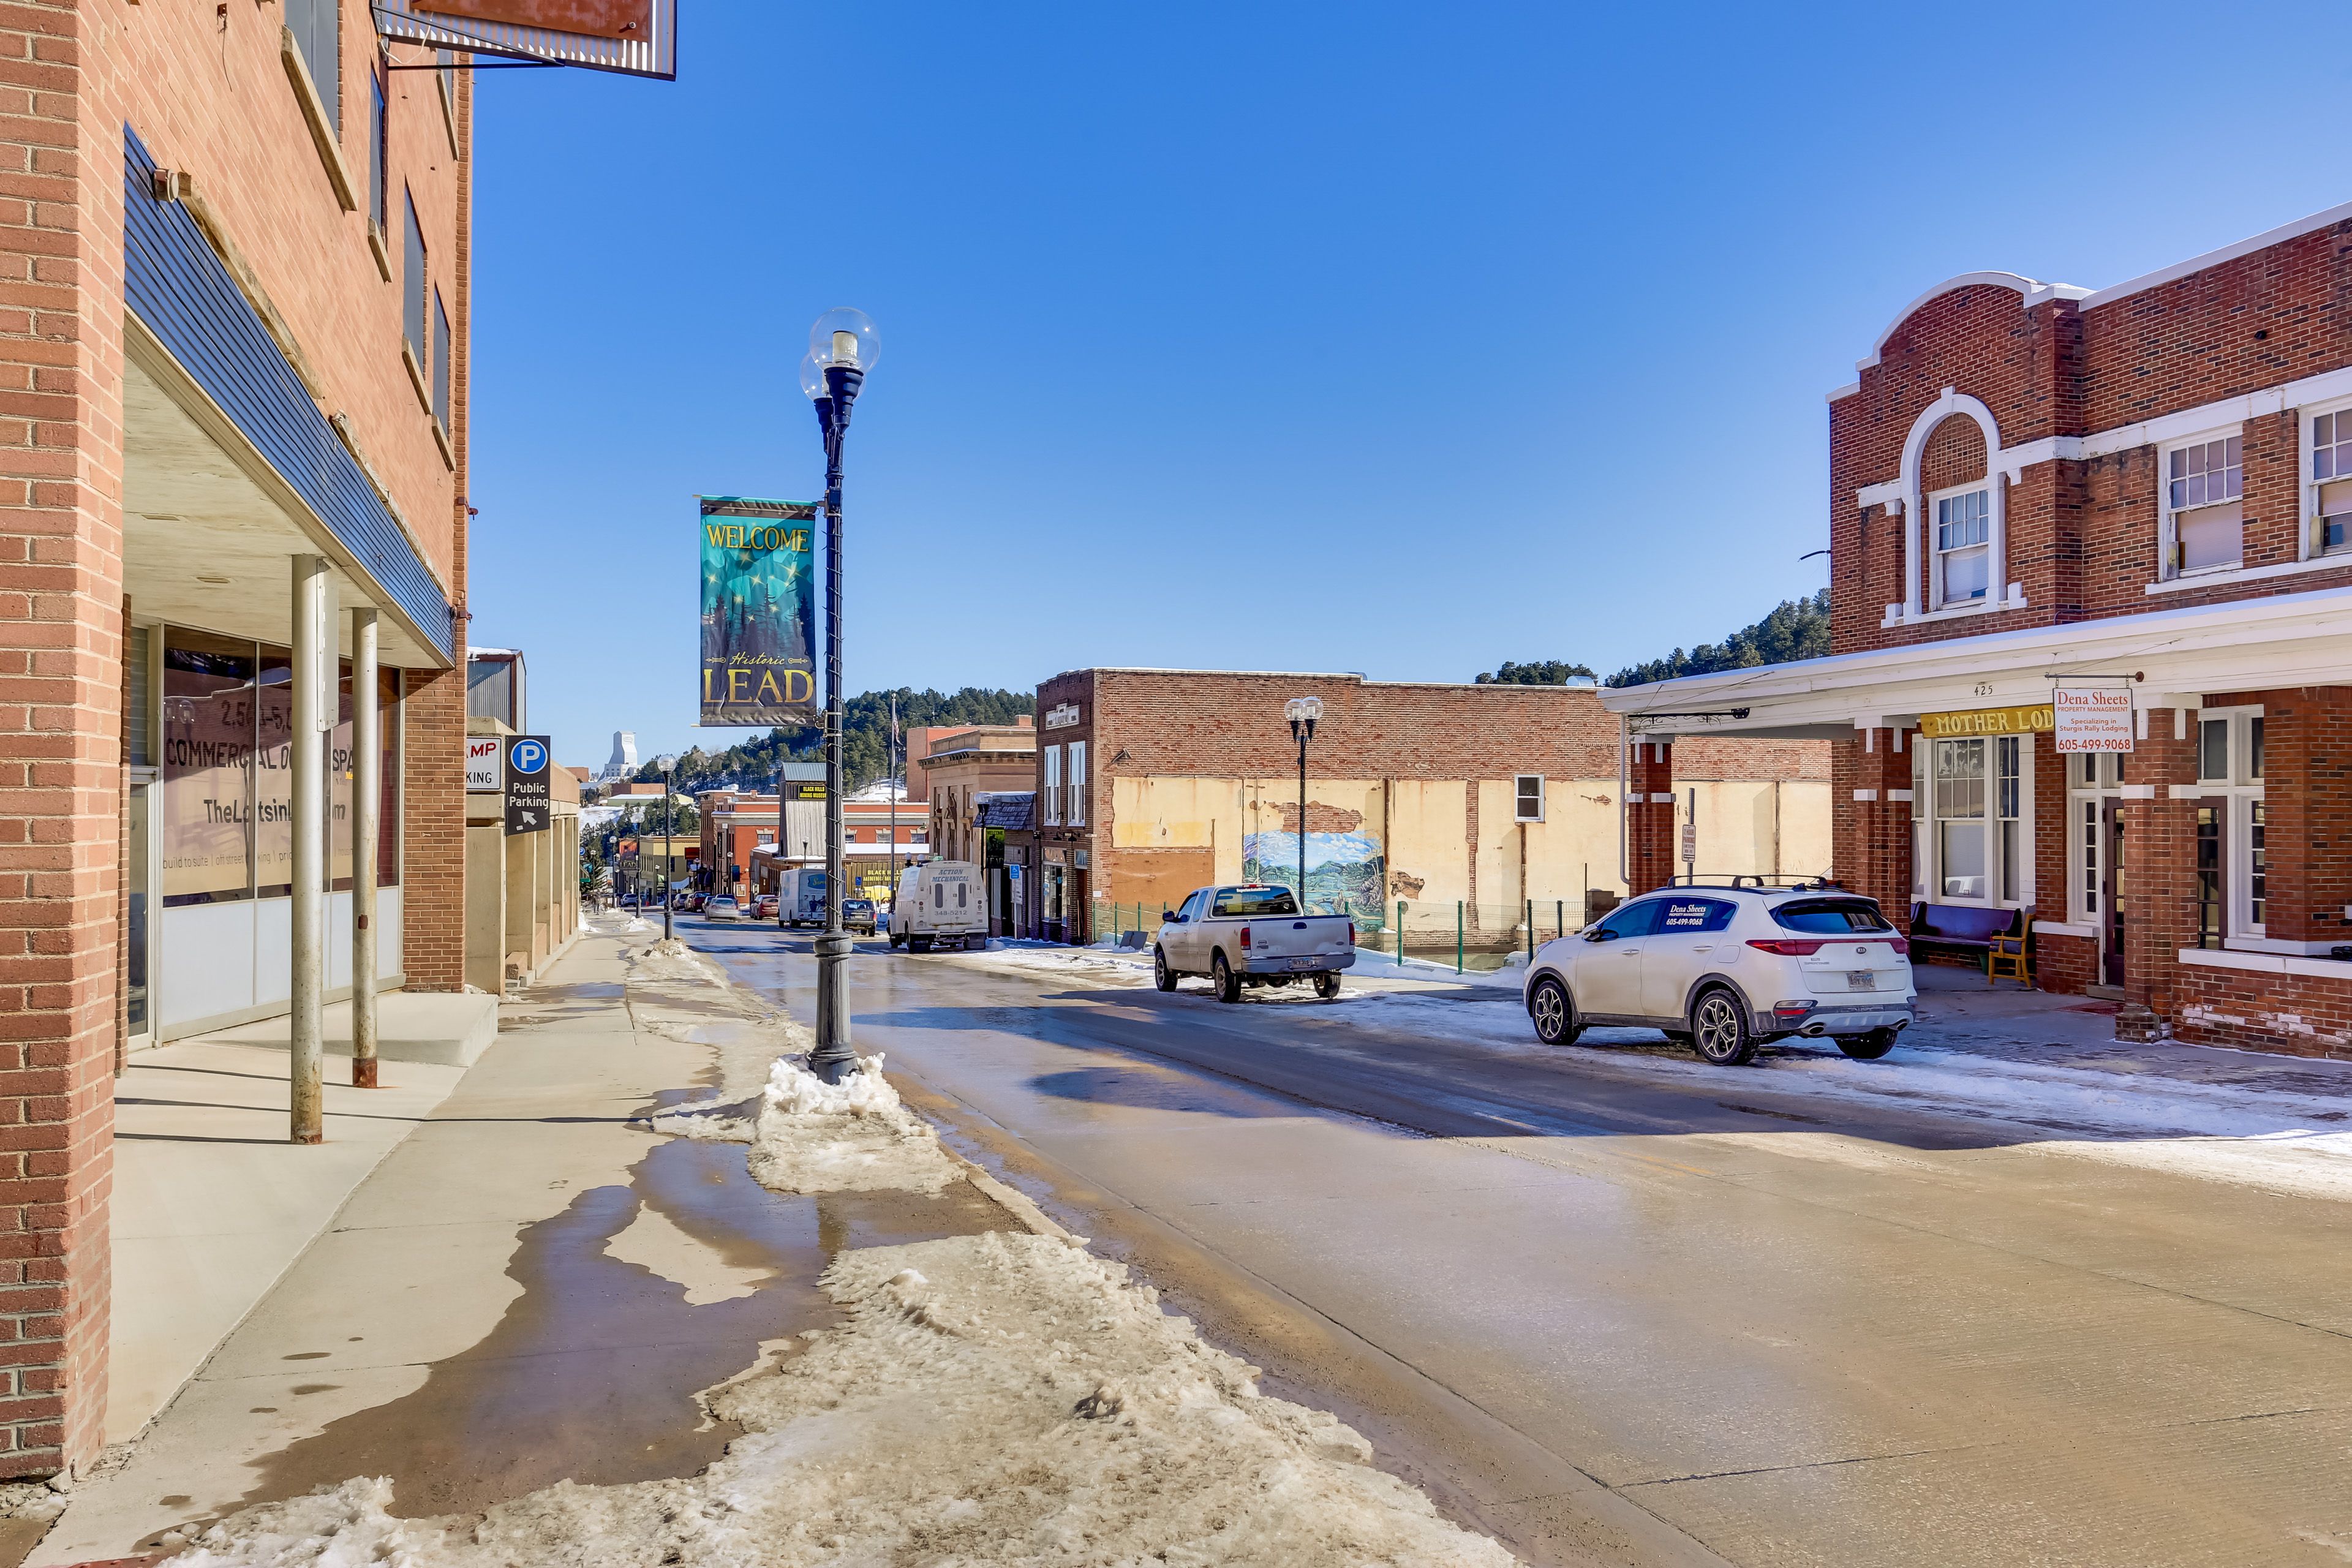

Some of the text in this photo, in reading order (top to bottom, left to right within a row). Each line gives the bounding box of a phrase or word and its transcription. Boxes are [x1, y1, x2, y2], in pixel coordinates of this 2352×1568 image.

[706, 524, 809, 552] WELCOME
[729, 651, 785, 665] Historic
[703, 668, 814, 704] LEAD
[1974, 685, 1993, 696] 425
[2057, 691, 2128, 705] Dena Sheets
[1935, 709, 2054, 734] MOTHER LOD
[2059, 739, 2130, 750] 605-499-9068
[165, 737, 277, 769] COMMERCAL
[513, 782, 546, 793] Public
[509, 796, 549, 810] Parking
[163, 856, 183, 869] build
[184, 856, 192, 868] to
[193, 855, 208, 867] suite
[226, 854, 244, 865] street
[1686, 903, 1706, 913] Sheets
